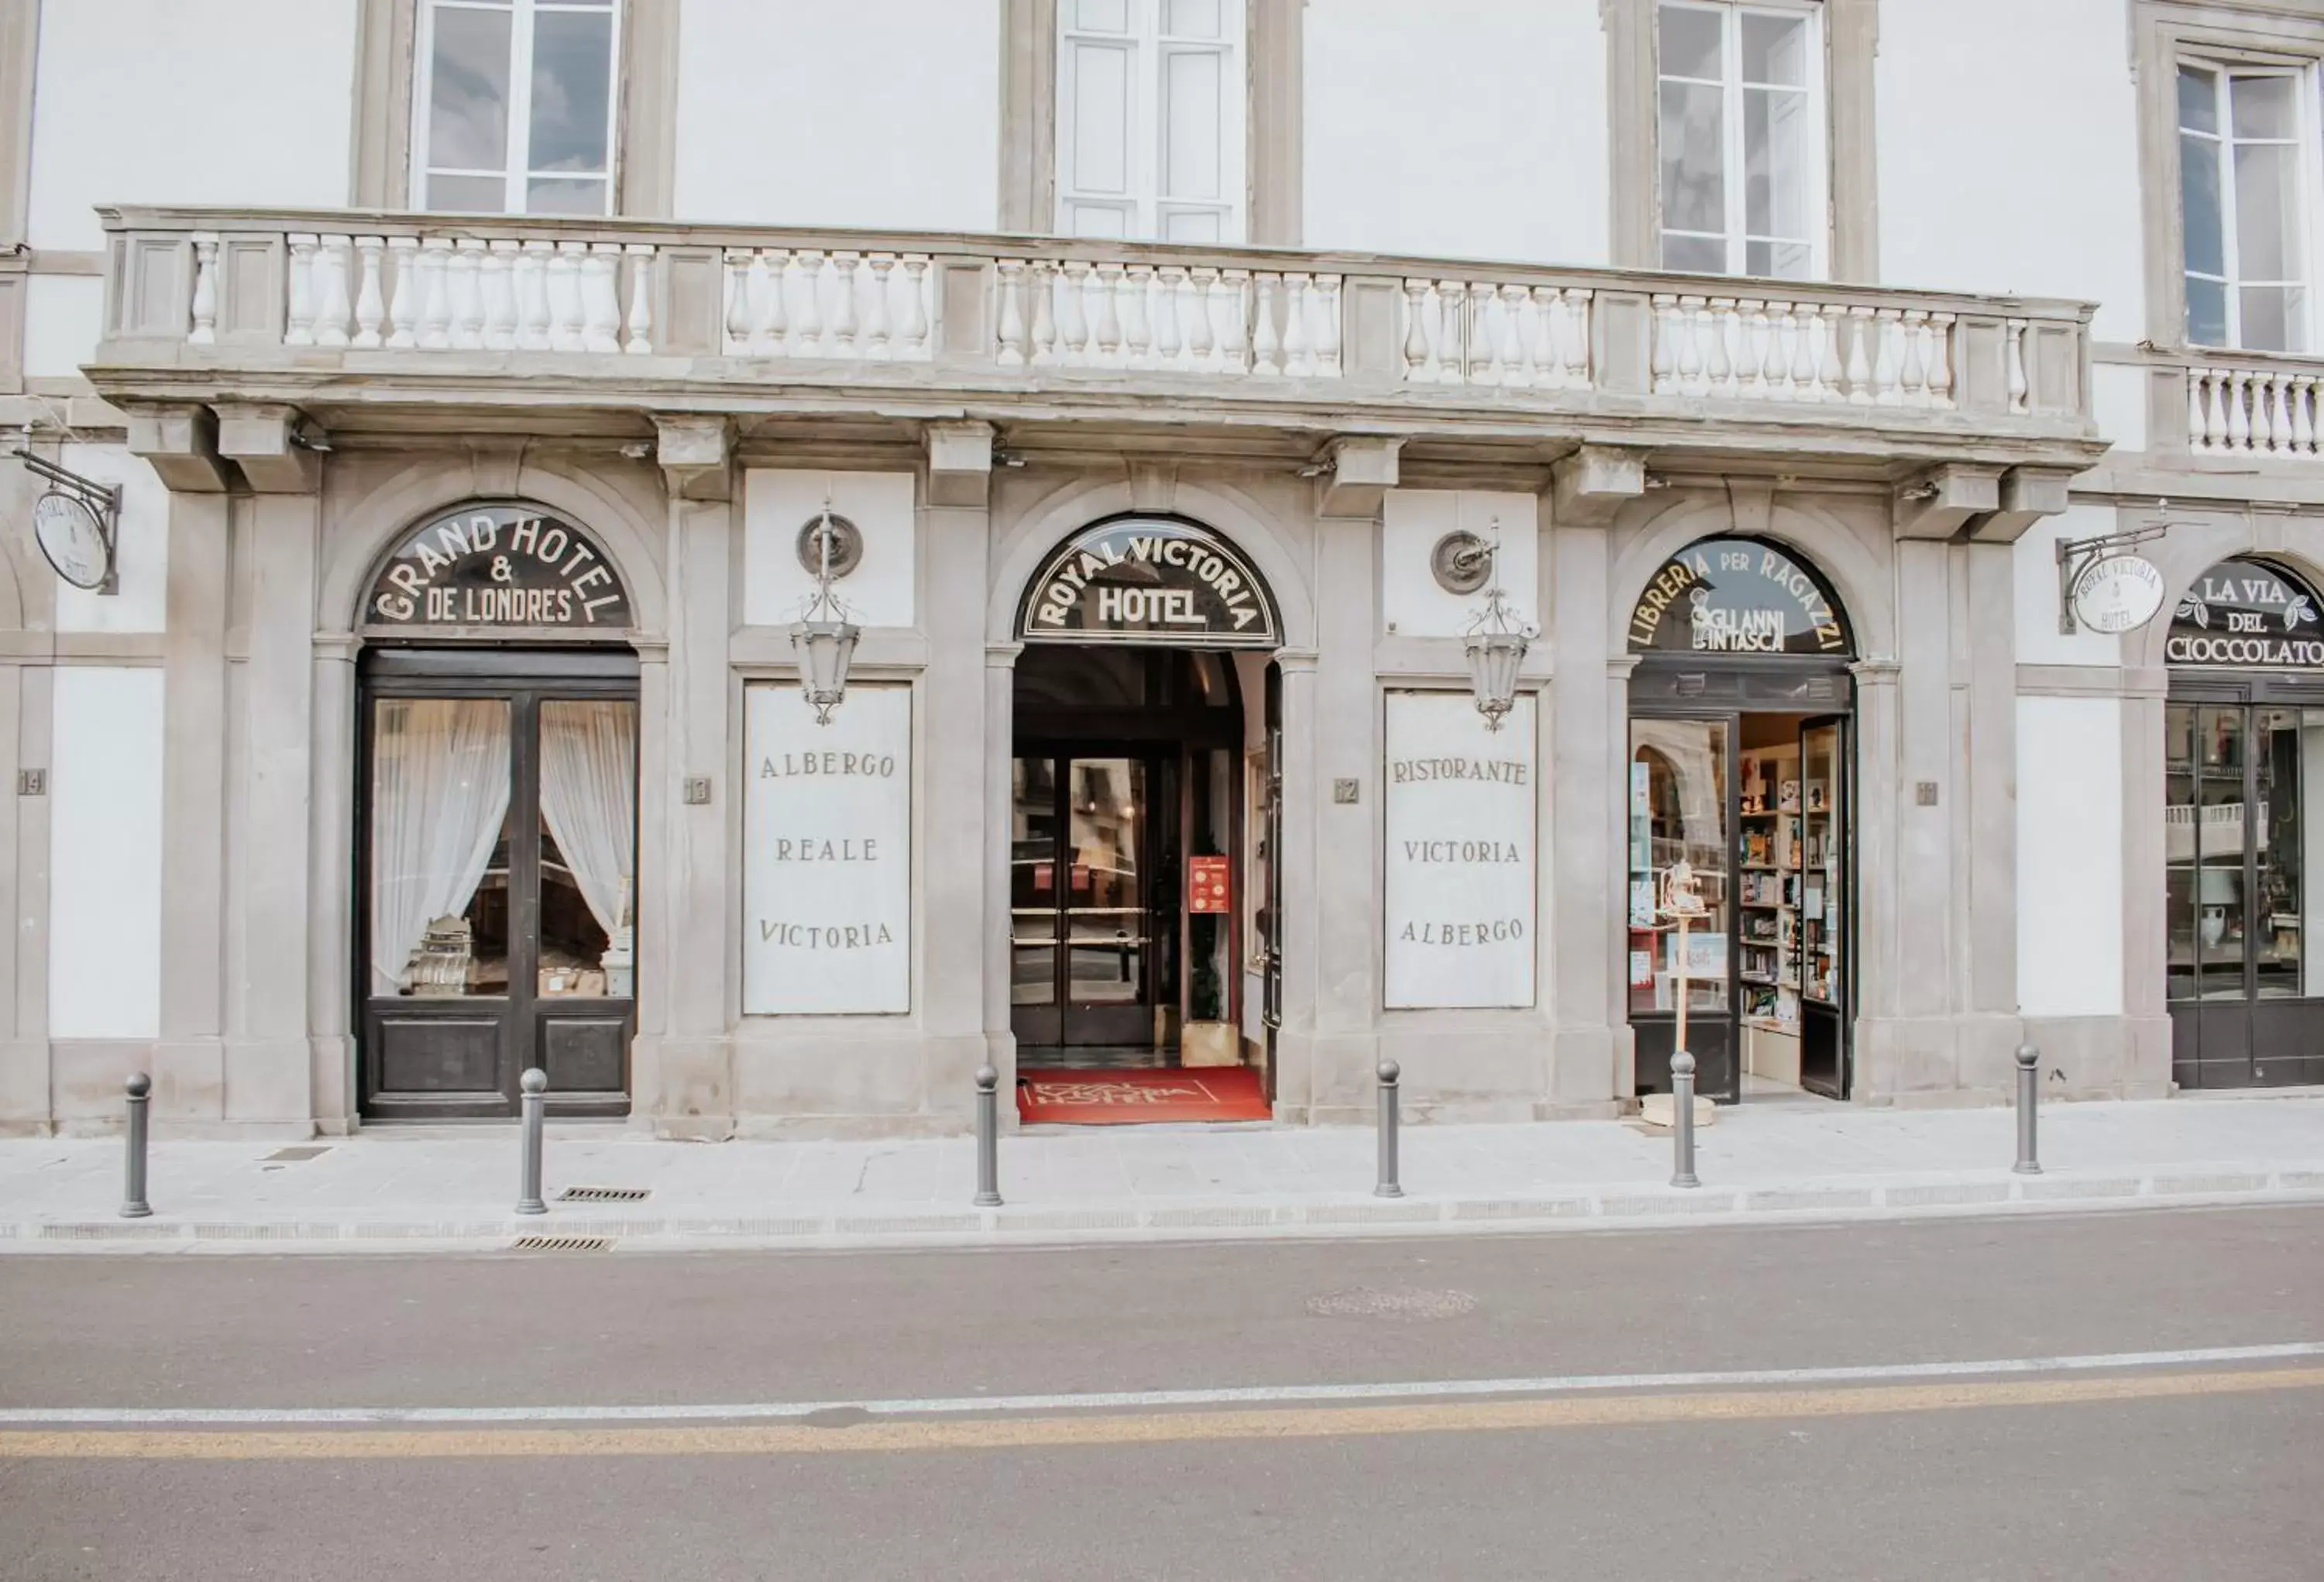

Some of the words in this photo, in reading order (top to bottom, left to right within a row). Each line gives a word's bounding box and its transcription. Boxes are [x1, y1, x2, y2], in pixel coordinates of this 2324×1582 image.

[376, 516, 497, 621] GRAND
[511, 518, 619, 623] HOTEL
[490, 555, 512, 582] &
[1038, 542, 1125, 626] ROYAL
[1127, 537, 1258, 631] VICTORIA
[2204, 578, 2239, 602] LA
[2242, 579, 2288, 604] VIA
[428, 587, 457, 621] DE
[466, 588, 572, 621] LONDRES
[1098, 587, 1206, 624] HOTEL
[1628, 552, 1711, 646] LIBRERIA
[1721, 552, 1749, 572] PER
[1759, 549, 1844, 650] RAGAZZI
[1743, 610, 1785, 632] ANNI
[2102, 609, 2134, 629] HOTEL
[2227, 613, 2268, 633] DEL
[1730, 630, 1785, 652] TASCA
[2167, 637, 2324, 664] CIOCCOLATO
[760, 751, 895, 779] ALBERGO
[1394, 758, 1528, 786] RISTORANTE
[776, 837, 878, 862] REALE
[1404, 841, 1521, 863] VICTORIA
[760, 918, 893, 950] VICTORIA
[1400, 918, 1524, 947] ALBERGO
